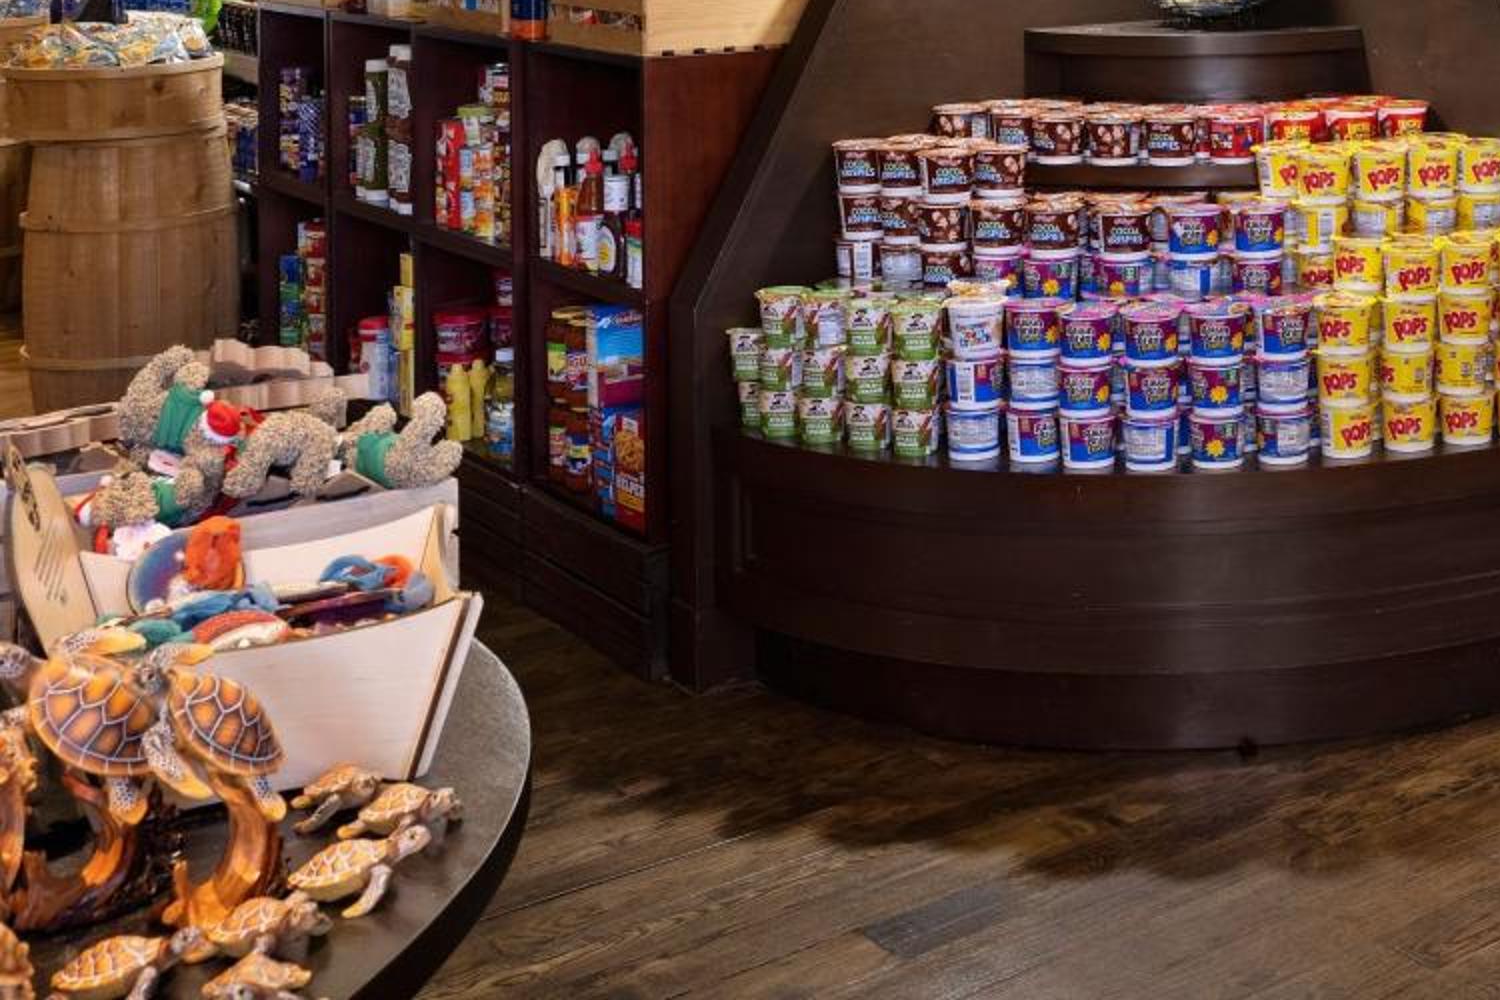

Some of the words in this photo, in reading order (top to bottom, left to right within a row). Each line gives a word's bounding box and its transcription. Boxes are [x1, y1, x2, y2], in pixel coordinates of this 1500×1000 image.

[1302, 171, 1336, 194] POPS
[1367, 167, 1400, 190] POPS
[1417, 165, 1451, 187] POPS
[1335, 256, 1367, 278] POPS
[1451, 262, 1486, 285] POPS
[1397, 267, 1433, 292] POPS
[1319, 320, 1352, 342] POPS
[1392, 316, 1429, 342] POPS
[1443, 311, 1478, 330] POPS
[1322, 373, 1357, 396] POPS
[1387, 418, 1422, 440] POPS
[1445, 411, 1479, 431] POPS
[1341, 421, 1372, 447] POPS
